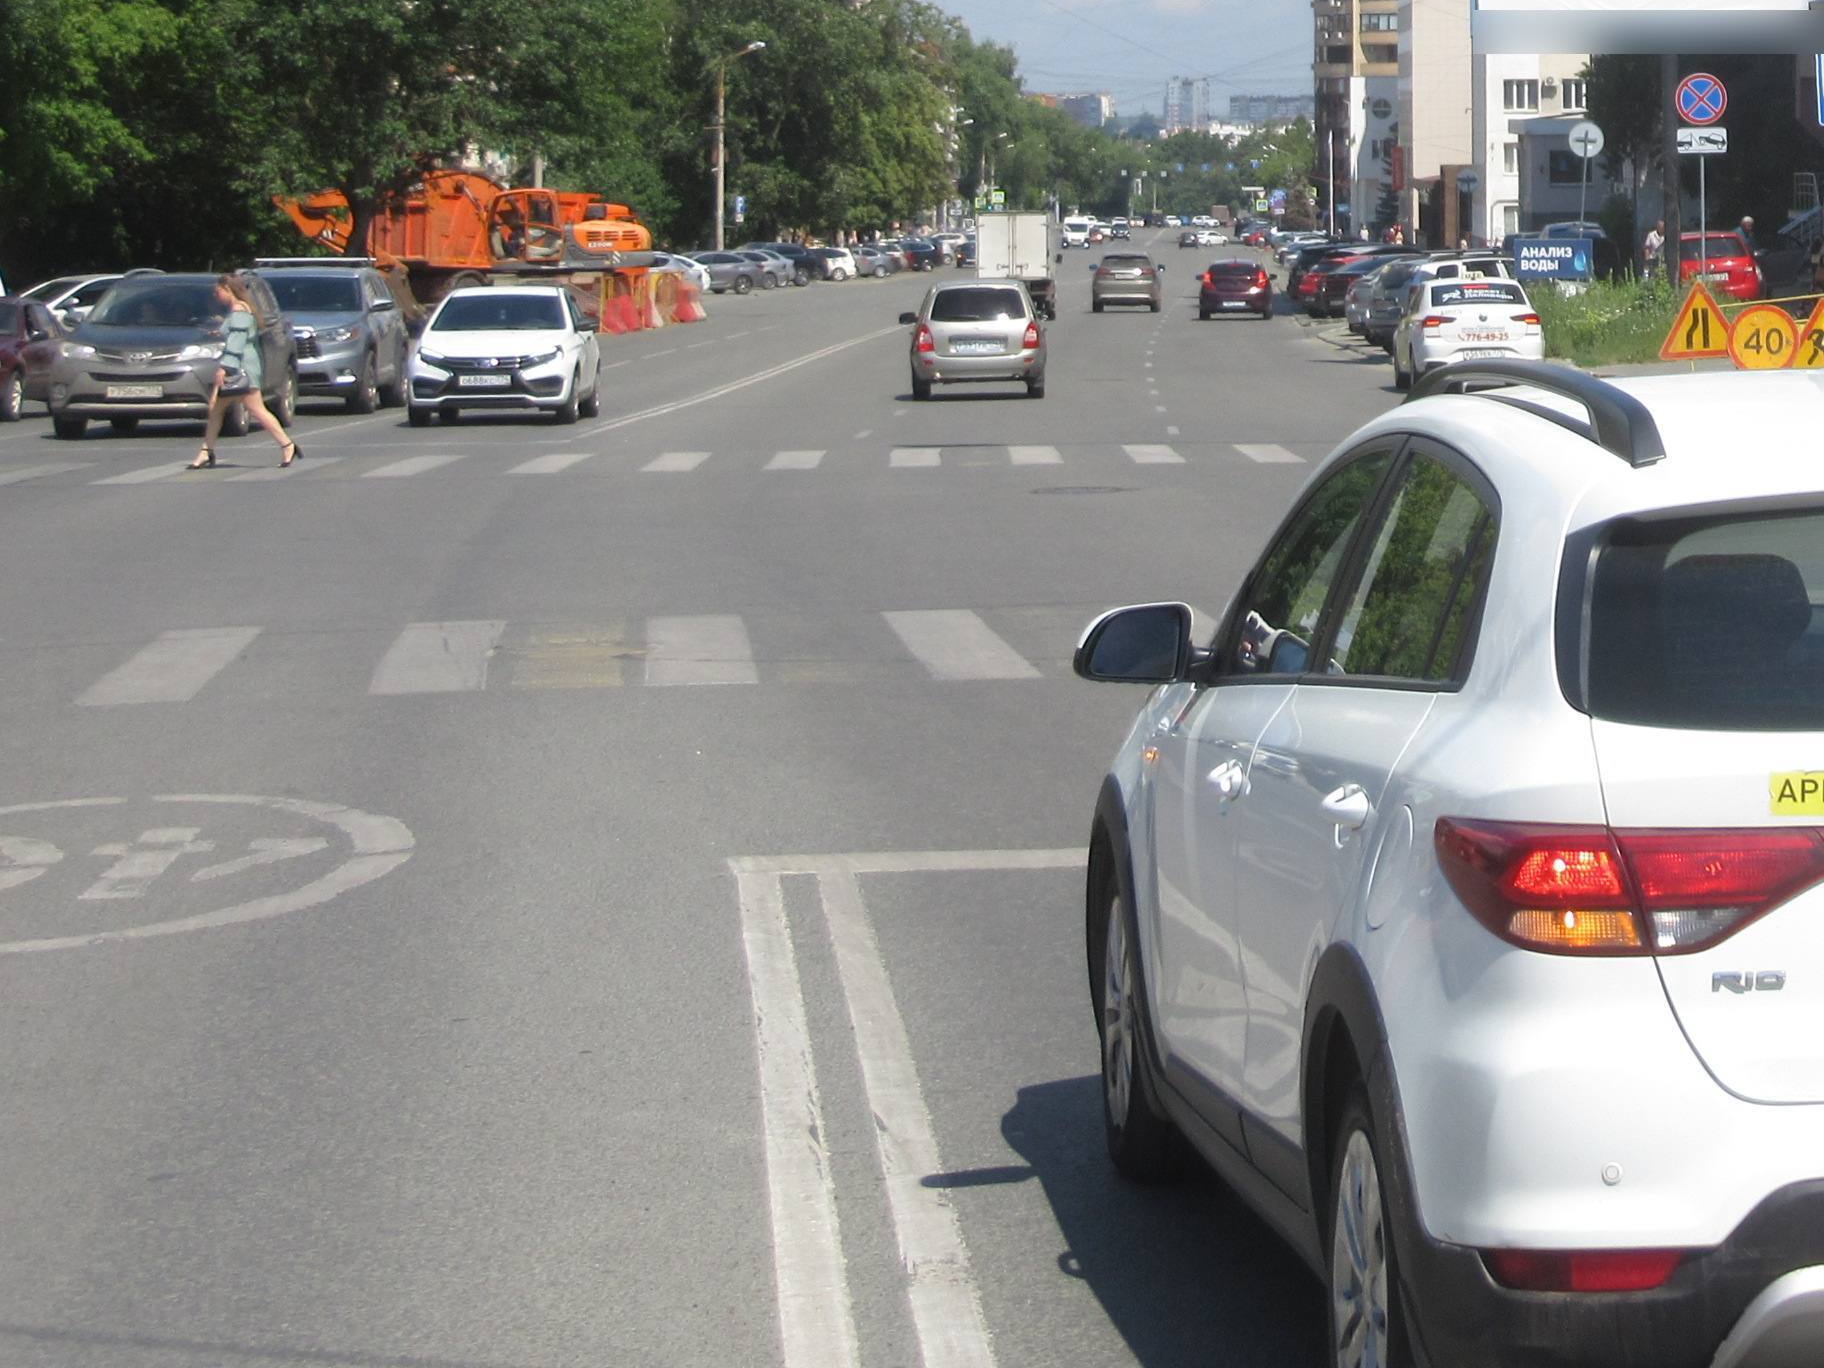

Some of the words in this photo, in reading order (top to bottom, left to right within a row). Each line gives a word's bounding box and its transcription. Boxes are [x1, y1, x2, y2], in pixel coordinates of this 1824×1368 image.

[1520, 247, 1573, 259] АНАЛИЗ
[1520, 259, 1559, 272] ВОДЫ
[1744, 327, 1784, 354] 40
[1711, 970, 1786, 994] RIO
